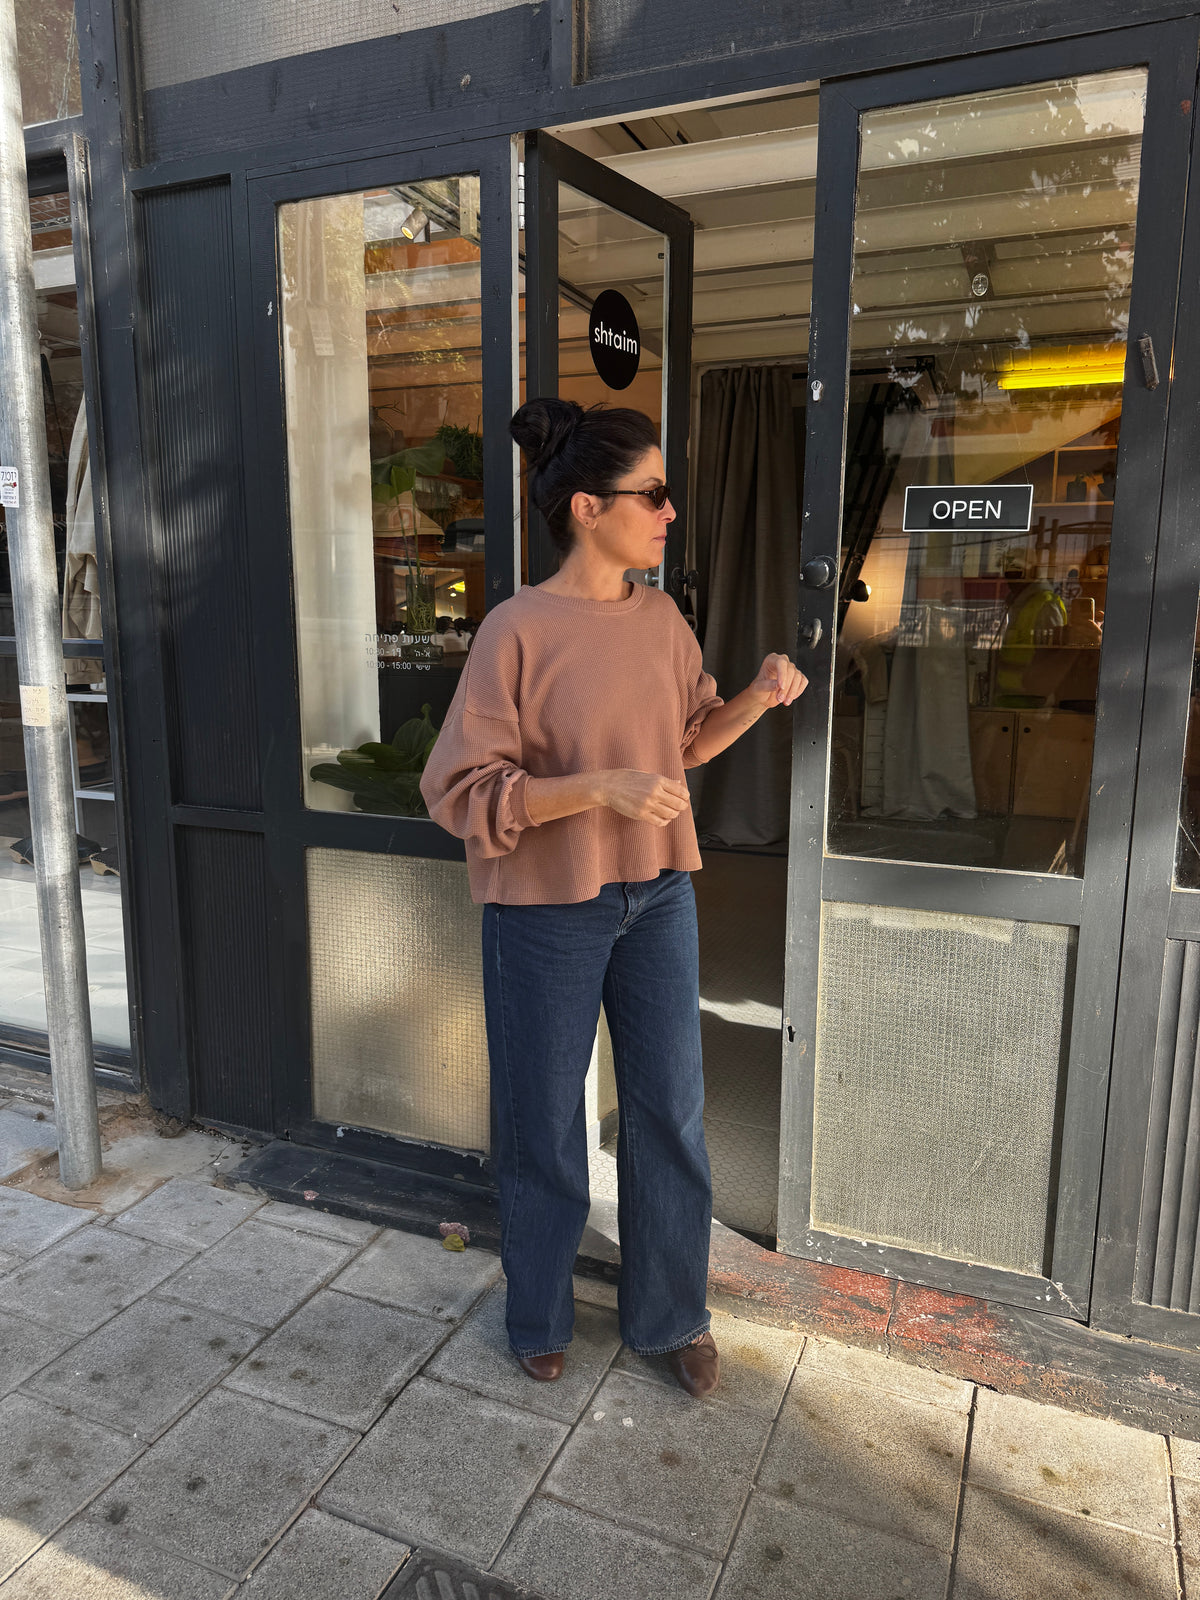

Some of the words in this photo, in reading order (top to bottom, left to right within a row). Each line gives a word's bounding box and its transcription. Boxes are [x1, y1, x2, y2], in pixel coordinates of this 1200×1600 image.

[594, 321, 638, 355] shtaim
[932, 500, 1002, 520] OPEN
[365, 633, 398, 643] פתיחה
[402, 634, 430, 644] שעות
[392, 661, 411, 670] 15:00
